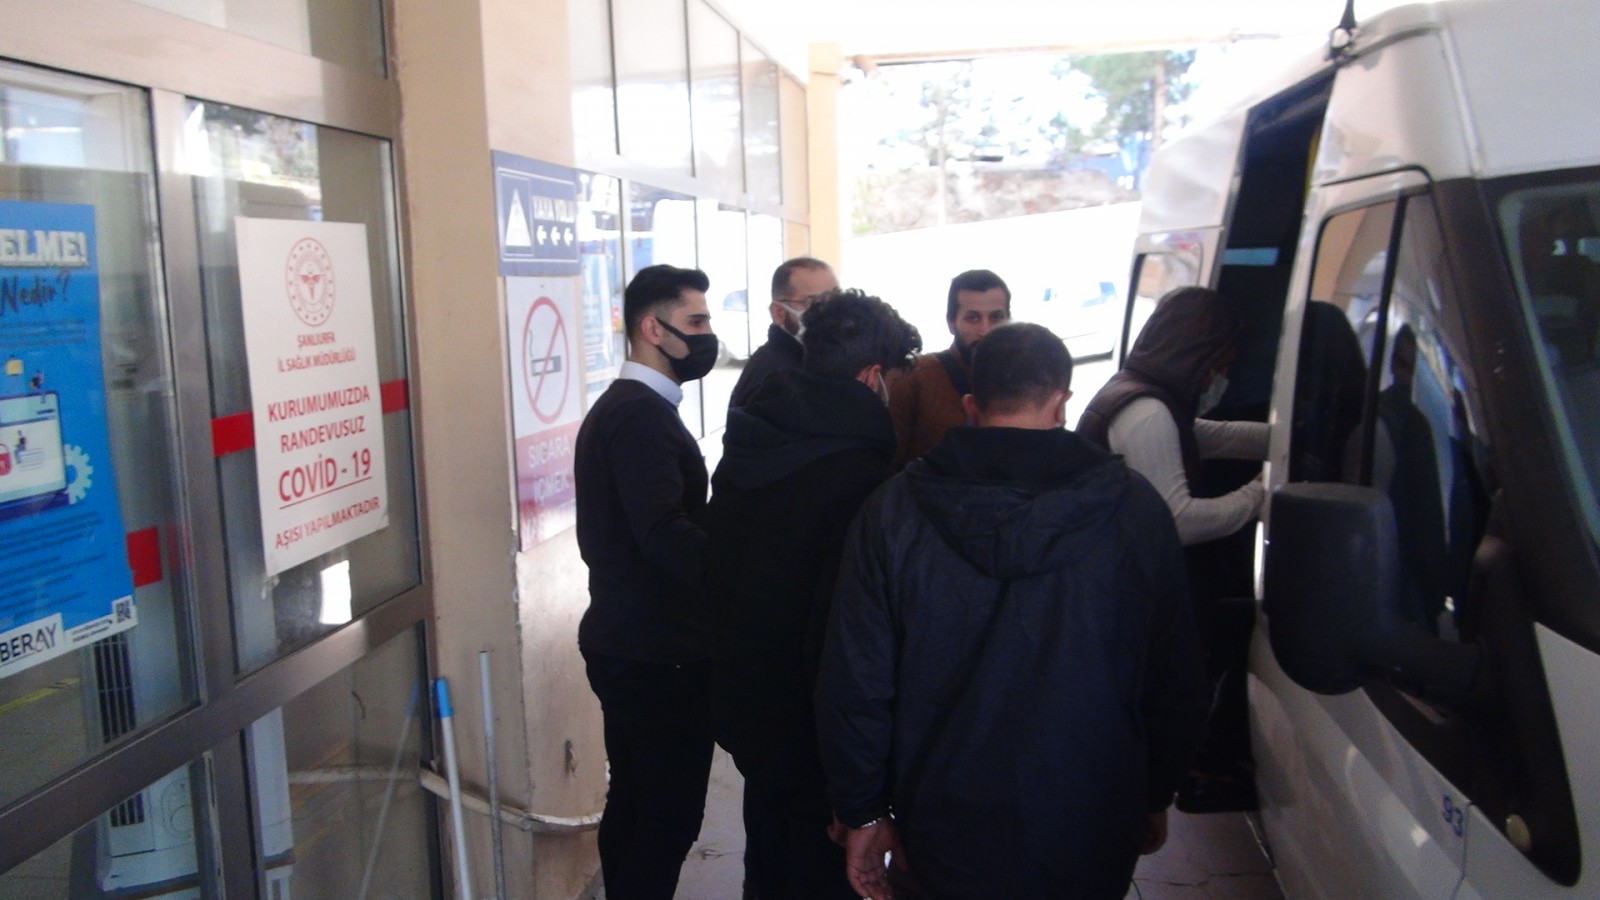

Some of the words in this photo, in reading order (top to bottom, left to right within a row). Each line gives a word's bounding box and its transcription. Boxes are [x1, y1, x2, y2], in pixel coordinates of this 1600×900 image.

[267, 385, 371, 422] KURUMUMUZDA
[280, 415, 366, 453] RANDEVUSUZ
[278, 453, 338, 502] COVİD
[351, 448, 372, 478] 19
[275, 526, 303, 550] AŞISI
[304, 496, 380, 534] YAPILMAKTADIR
